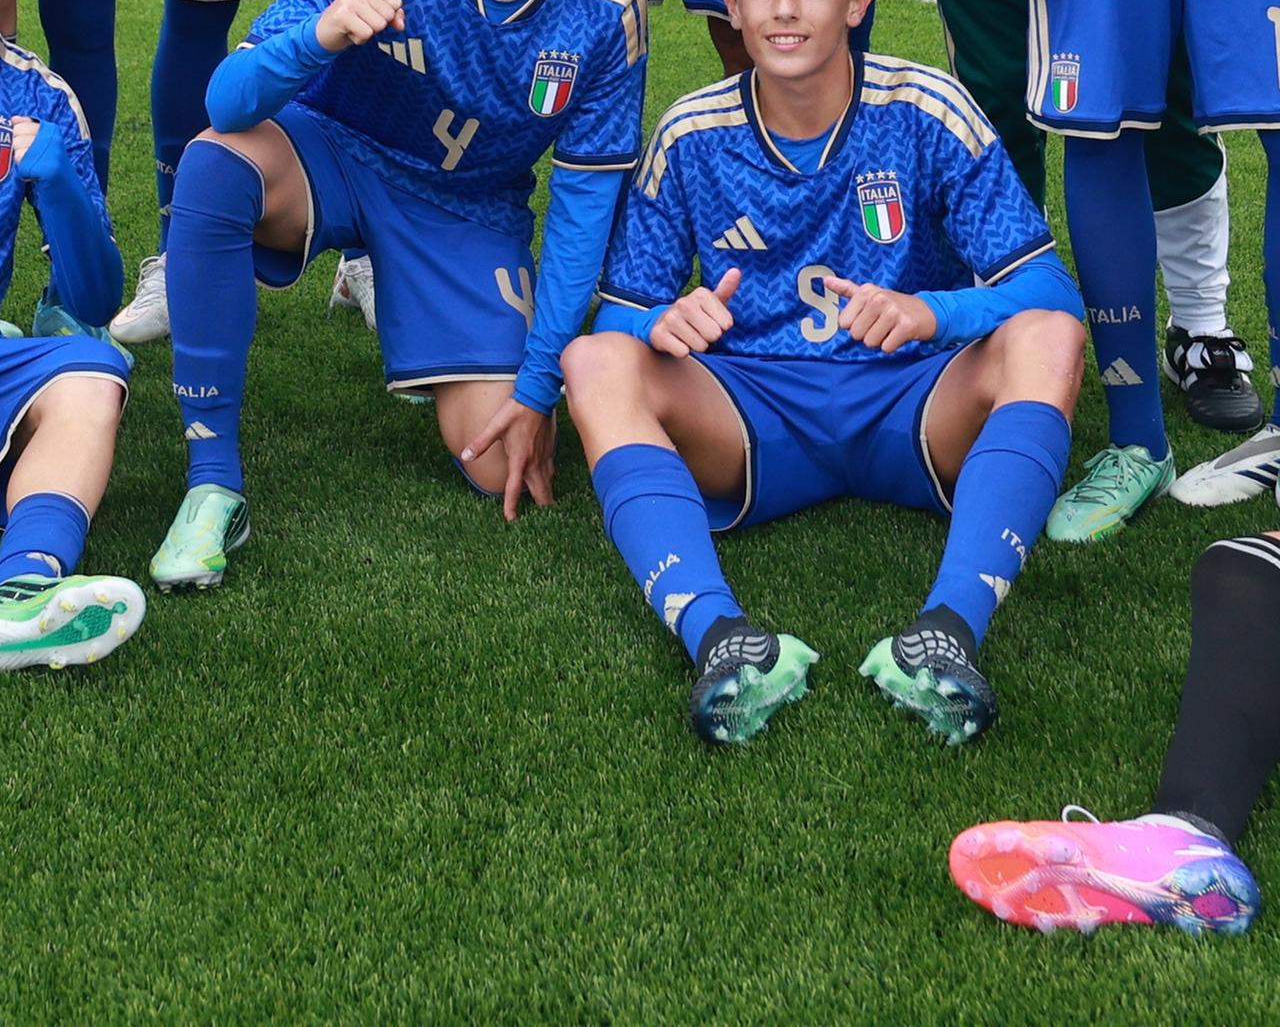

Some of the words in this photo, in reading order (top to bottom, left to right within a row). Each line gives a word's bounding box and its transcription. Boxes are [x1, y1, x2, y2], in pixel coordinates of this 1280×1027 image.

[538, 65, 572, 79] ITALIA
[433, 109, 480, 171] 4
[860, 186, 897, 201] ITALIA
[495, 267, 535, 334] 4
[1086, 305, 1141, 324] TALIA
[173, 382, 218, 398] TALIA
